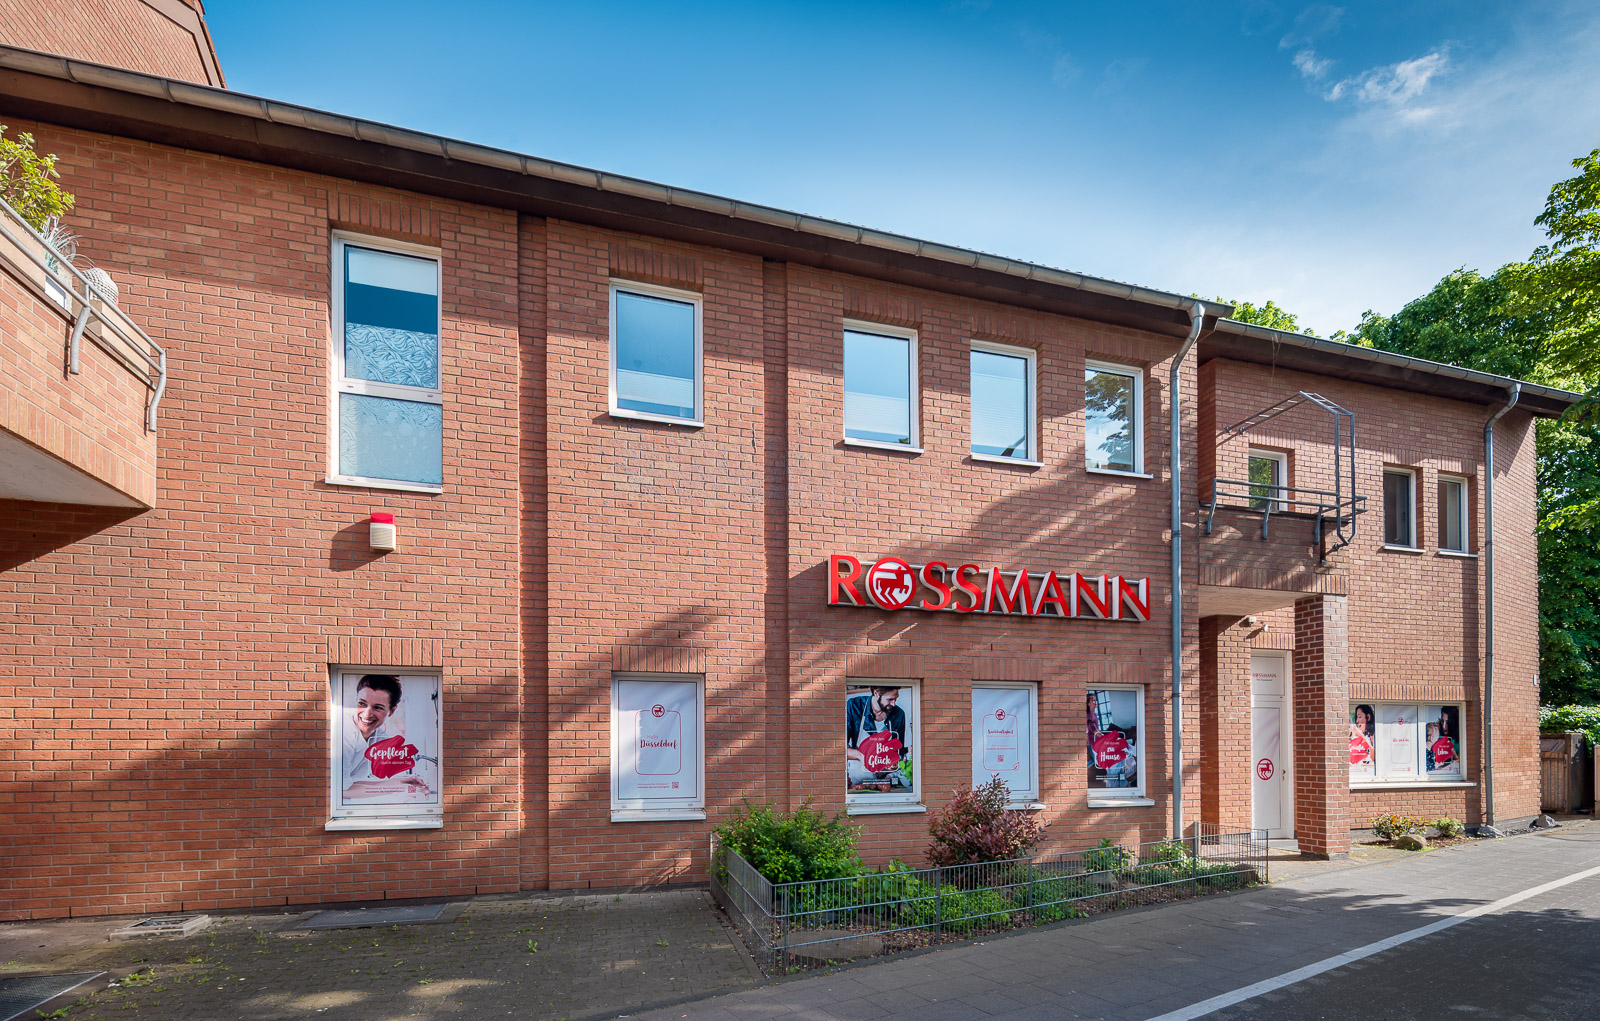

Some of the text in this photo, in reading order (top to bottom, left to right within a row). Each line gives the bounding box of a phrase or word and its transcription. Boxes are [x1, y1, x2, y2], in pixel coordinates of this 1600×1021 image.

[827, 554, 1151, 621] ROSSMANN
[640, 739, 677, 750] Düsseldorf
[876, 742, 894, 755] Bio-
[369, 746, 409, 760] Gepflegt
[1100, 751, 1121, 762] Hause
[868, 754, 892, 768] Glück
